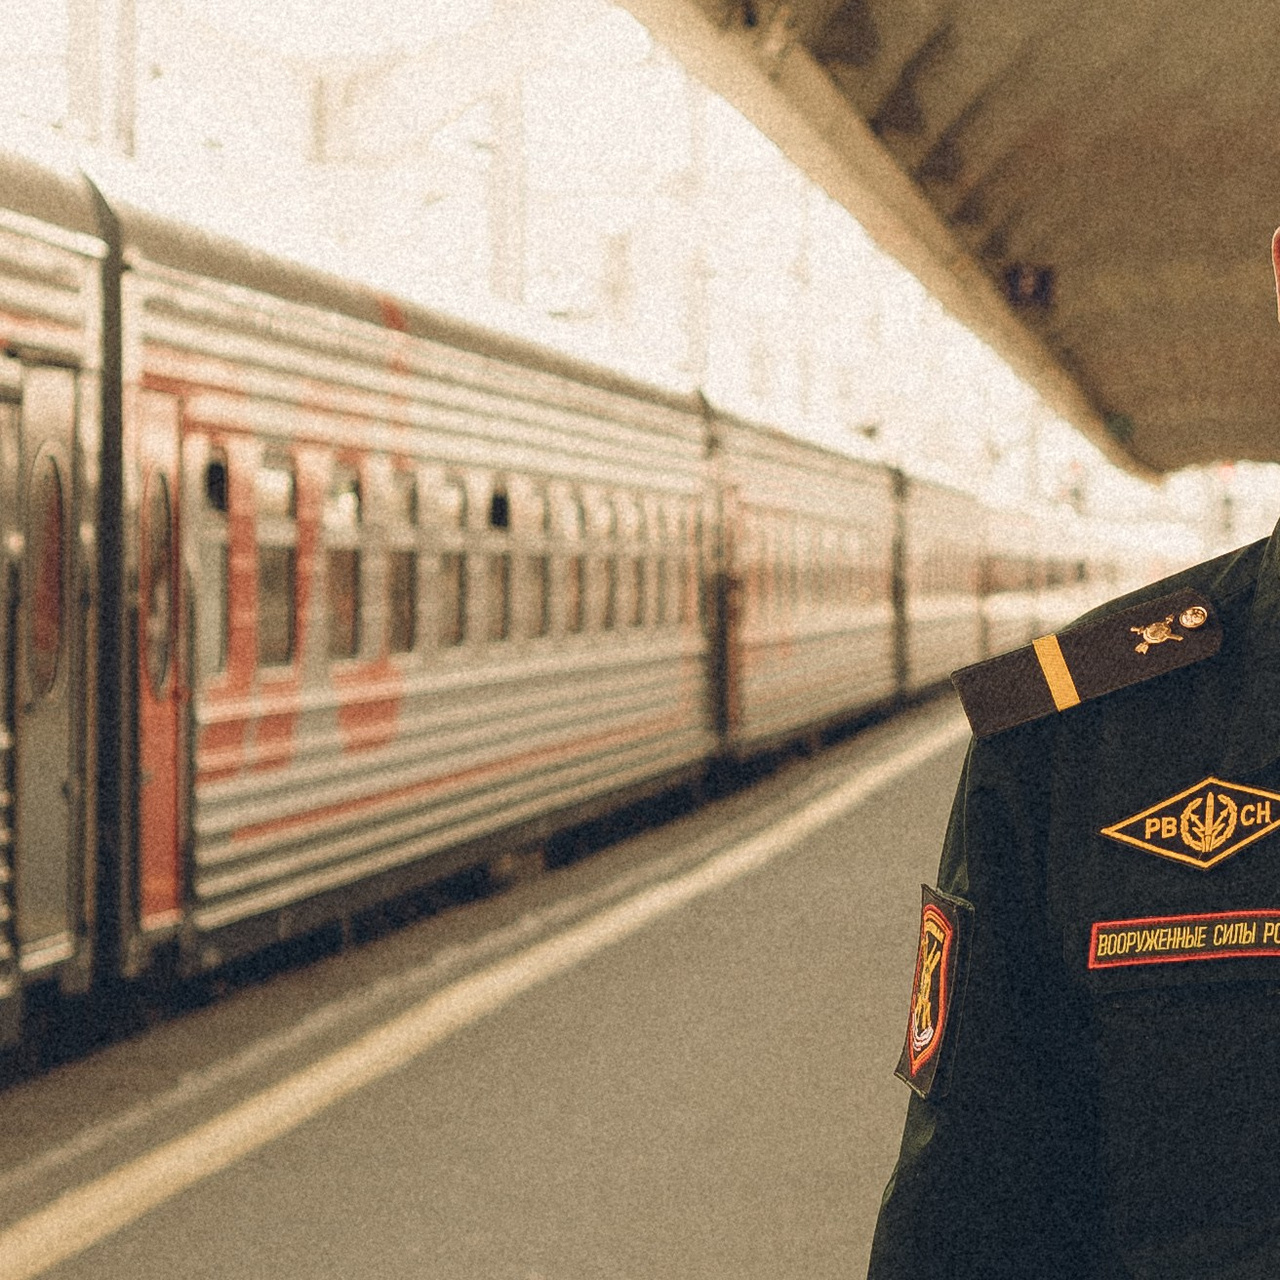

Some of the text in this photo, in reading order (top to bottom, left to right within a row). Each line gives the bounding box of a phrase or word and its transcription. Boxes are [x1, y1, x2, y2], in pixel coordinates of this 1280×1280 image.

[1145, 801, 1272, 839] РВ СН
[1097, 926, 1208, 956] ВООРУЖЕННЫЕ
[1213, 922, 1257, 946] СИЛЫ
